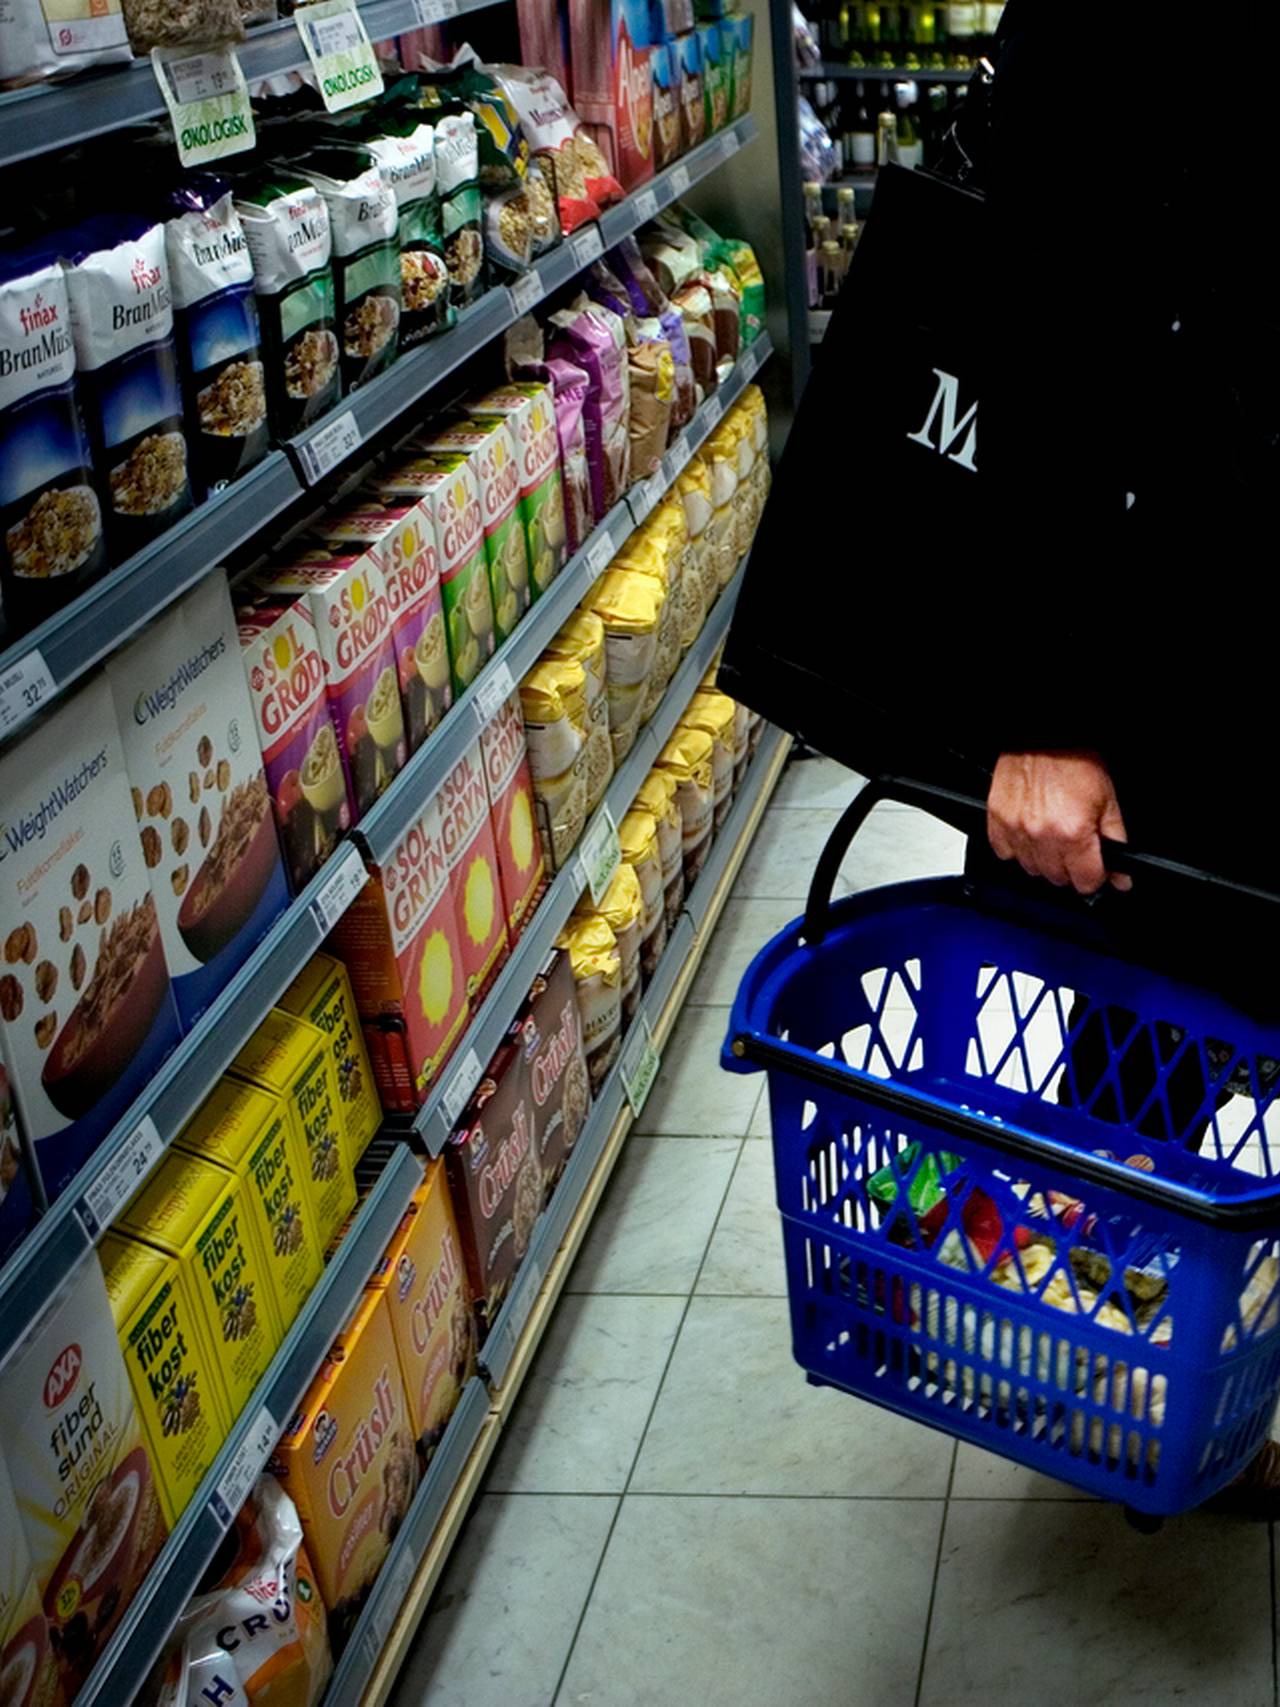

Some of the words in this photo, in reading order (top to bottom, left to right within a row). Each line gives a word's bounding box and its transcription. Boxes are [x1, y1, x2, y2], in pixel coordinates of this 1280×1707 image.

[323, 65, 376, 96] ØKOLOGISK
[181, 114, 248, 150] ØKOLOGISK
[130, 266, 161, 294] finax
[20, 304, 58, 336] finax
[906, 367, 978, 472] M
[385, 546, 439, 611] GRØD
[337, 596, 389, 670] GRØD
[149, 633, 226, 718] WeightWatchers
[261, 650, 322, 735] GRØD
[5, 747, 108, 852] WeightWatchers
[442, 770, 485, 854] GRYN
[396, 820, 430, 882] SOL
[394, 838, 443, 932] GRYN
[332, 1021, 353, 1061] ost
[296, 1069, 328, 1121] fiber
[303, 1097, 335, 1147] kost
[254, 1136, 287, 1194] fiber
[263, 1164, 294, 1222] kost
[202, 1215, 239, 1280] fiber
[211, 1244, 247, 1306] kost
[136, 1301, 179, 1372] fiber
[147, 1332, 188, 1400] kost
[47, 1349, 80, 1398] AXA
[50, 1382, 96, 1457] fiber
[58, 1403, 103, 1482] sund
[53, 1421, 118, 1518] ORIGINAL
